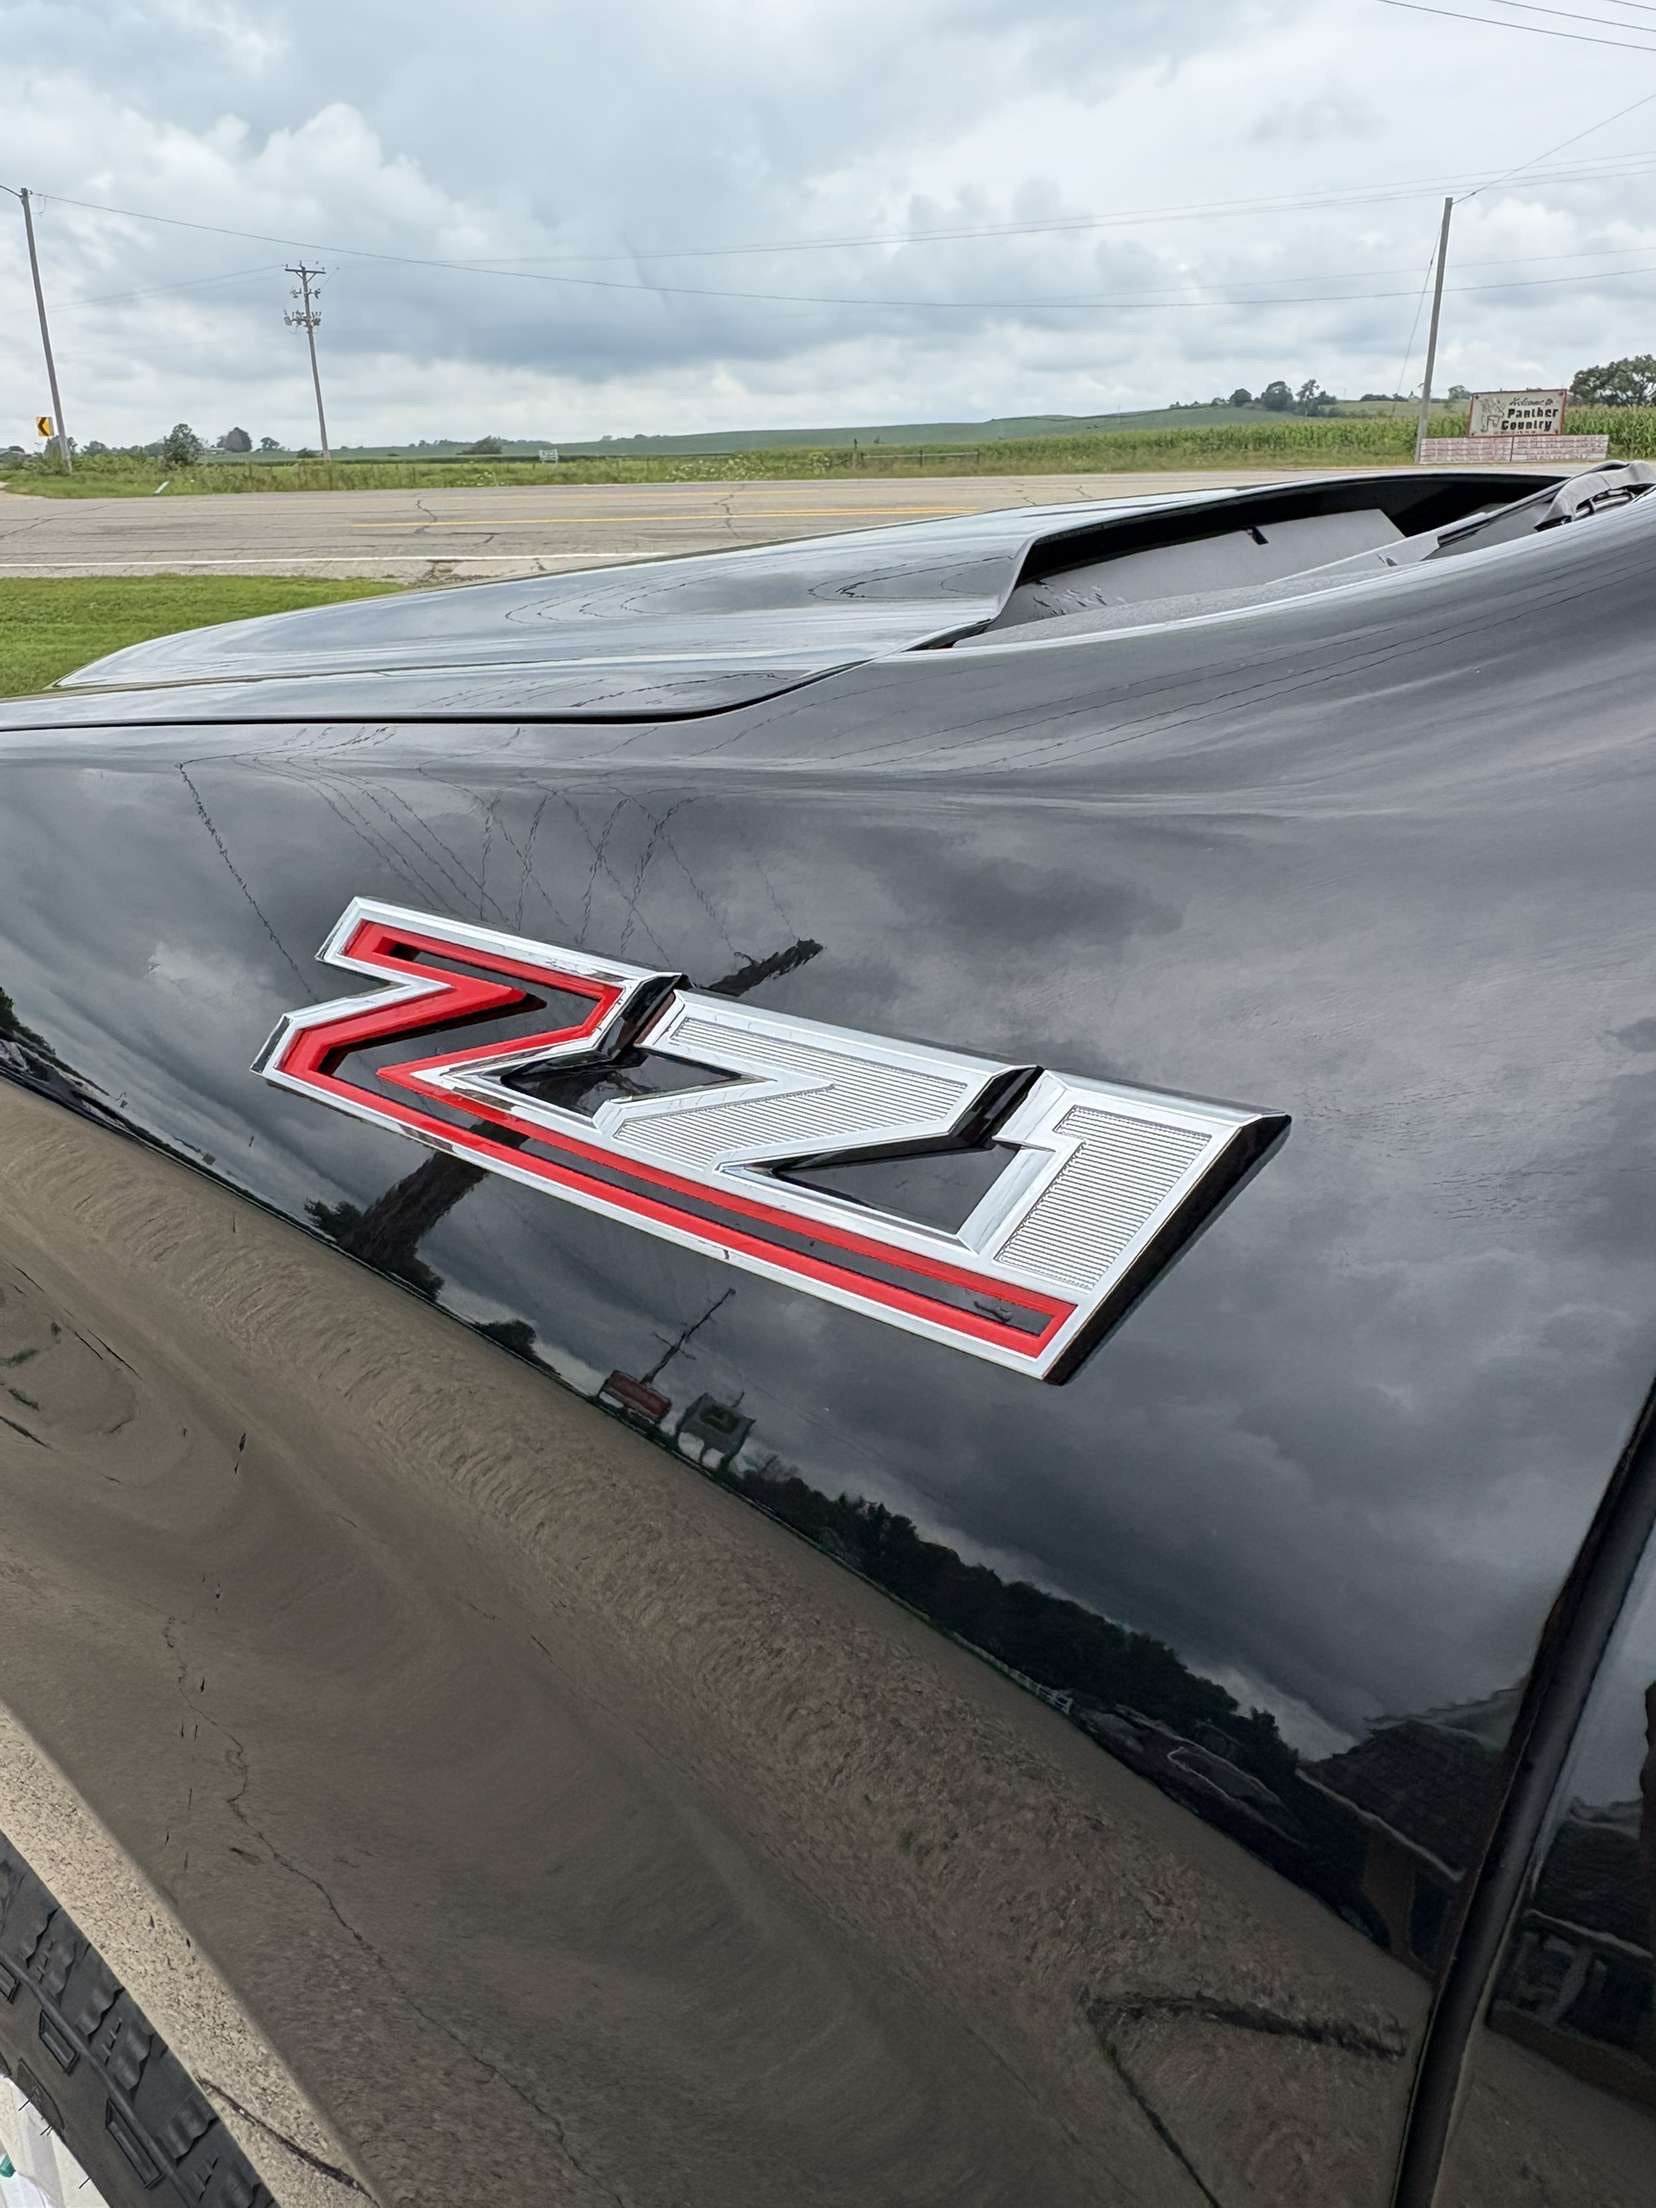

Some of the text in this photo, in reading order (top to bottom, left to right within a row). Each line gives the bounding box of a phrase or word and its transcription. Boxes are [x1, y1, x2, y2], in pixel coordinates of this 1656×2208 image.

[1507, 407, 1559, 418] Panther
[1501, 419, 1552, 432] Country
[250, 896, 1290, 1384] Z71
